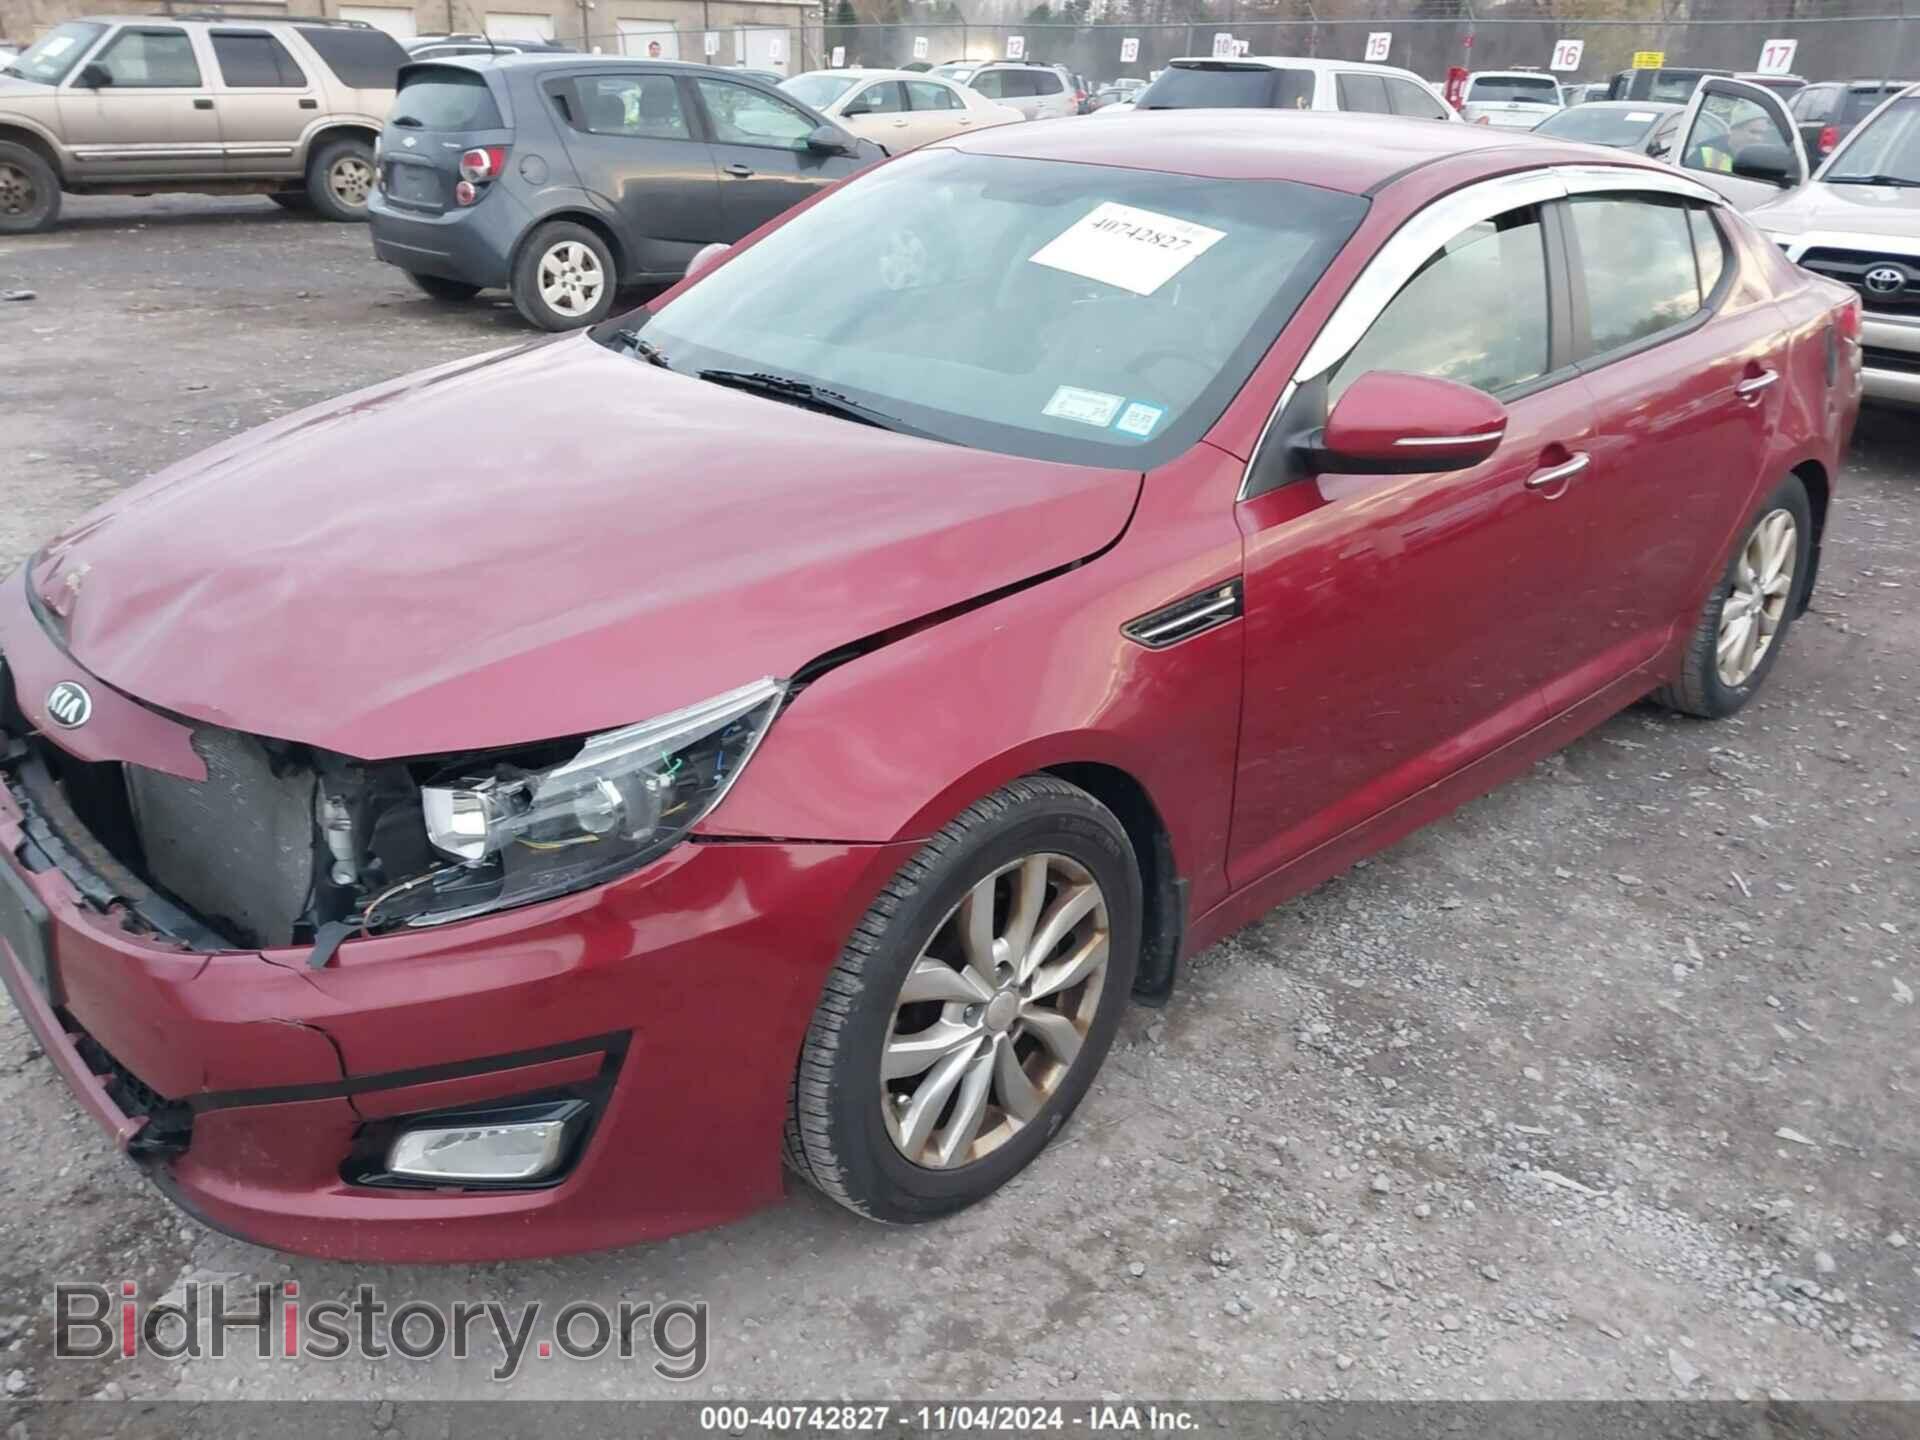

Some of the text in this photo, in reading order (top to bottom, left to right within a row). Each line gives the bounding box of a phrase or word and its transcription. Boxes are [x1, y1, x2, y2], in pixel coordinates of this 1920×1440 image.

[1369, 38, 1387, 56] 15
[1558, 46, 1578, 65] 16
[1766, 46, 1791, 68] 17
[1092, 218, 1193, 250] 40742827
